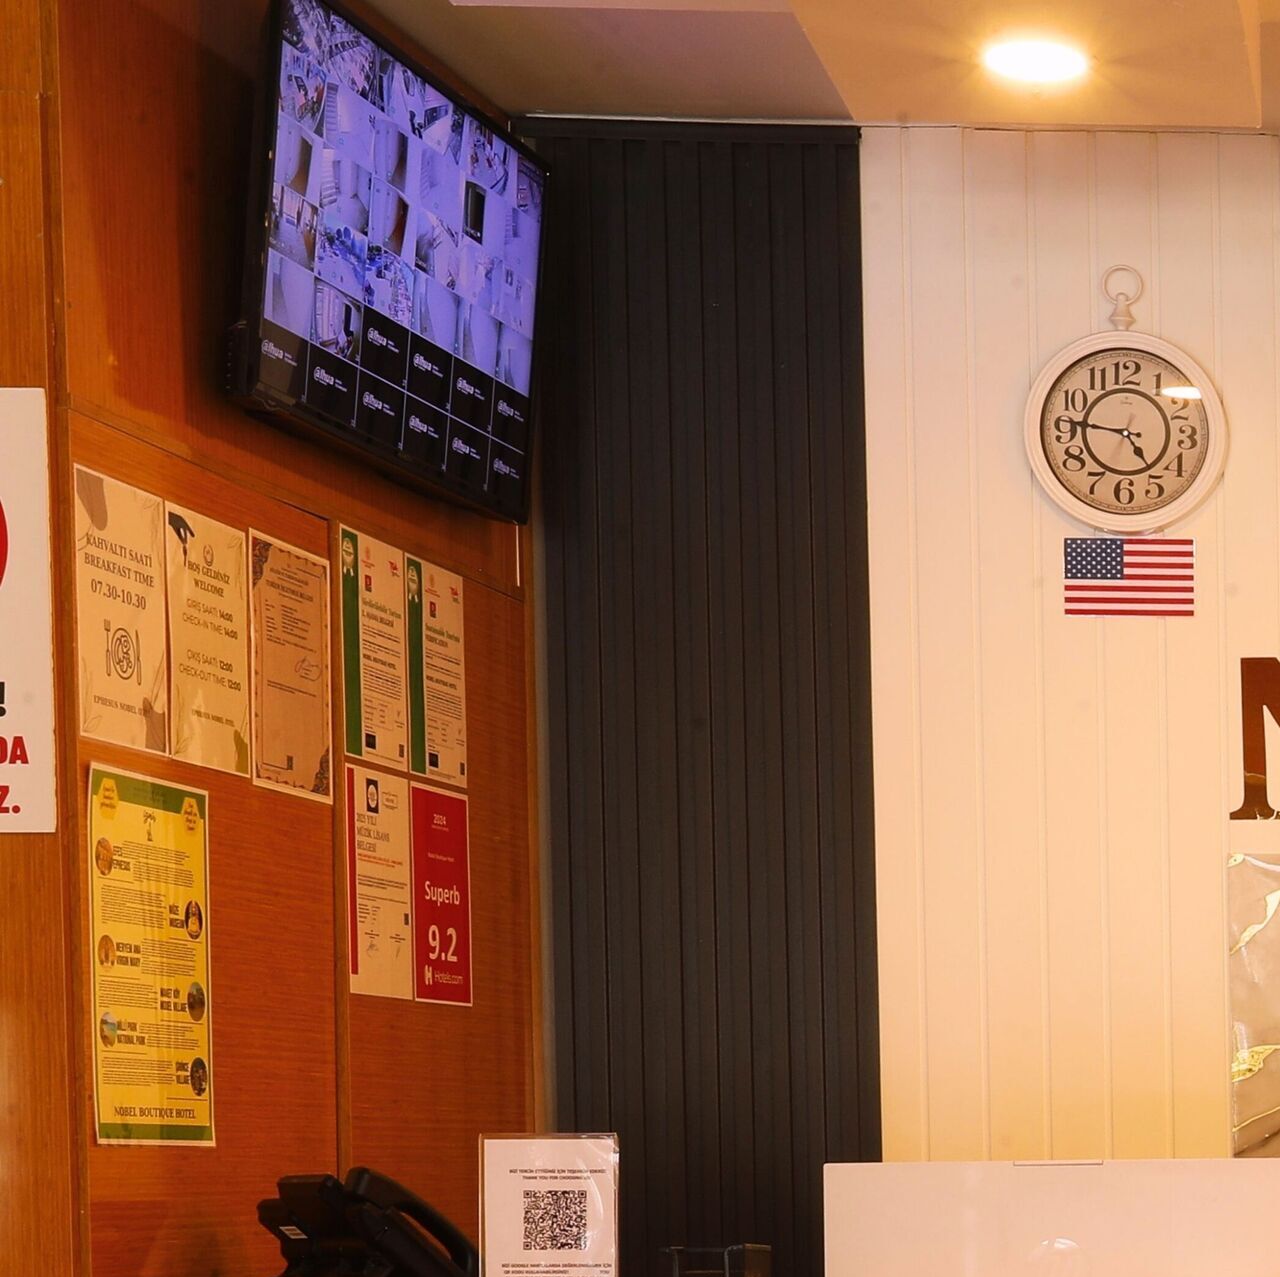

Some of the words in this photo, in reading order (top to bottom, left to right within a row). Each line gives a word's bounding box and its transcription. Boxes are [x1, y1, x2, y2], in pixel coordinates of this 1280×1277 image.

[1088, 366, 1107, 391] 11
[1112, 359, 1142, 386] 12
[1152, 372, 1162, 396] 1
[1063, 388, 1088, 413] 10
[1171, 398, 1189, 421] 2
[1054, 415, 1078, 444] 9
[1177, 424, 1197, 450] 3
[1062, 445, 1086, 472] 8
[1163, 452, 1187, 478] 4
[1086, 471, 1106, 495] 7
[1113, 478, 1135, 505] 6
[1145, 474, 1165, 499] 5
[84, 552, 132, 578] BREAKFAST
[133, 569, 155, 588] TIME
[90, 578, 147, 610] 07.30-10.30
[193, 578, 224, 598] WELCOME
[424, 880, 460, 905] Superb
[428, 924, 458, 962] 9.2
[114, 1105, 138, 1118] NOBEL
[139, 1106, 175, 1120] BOUTIQUE
